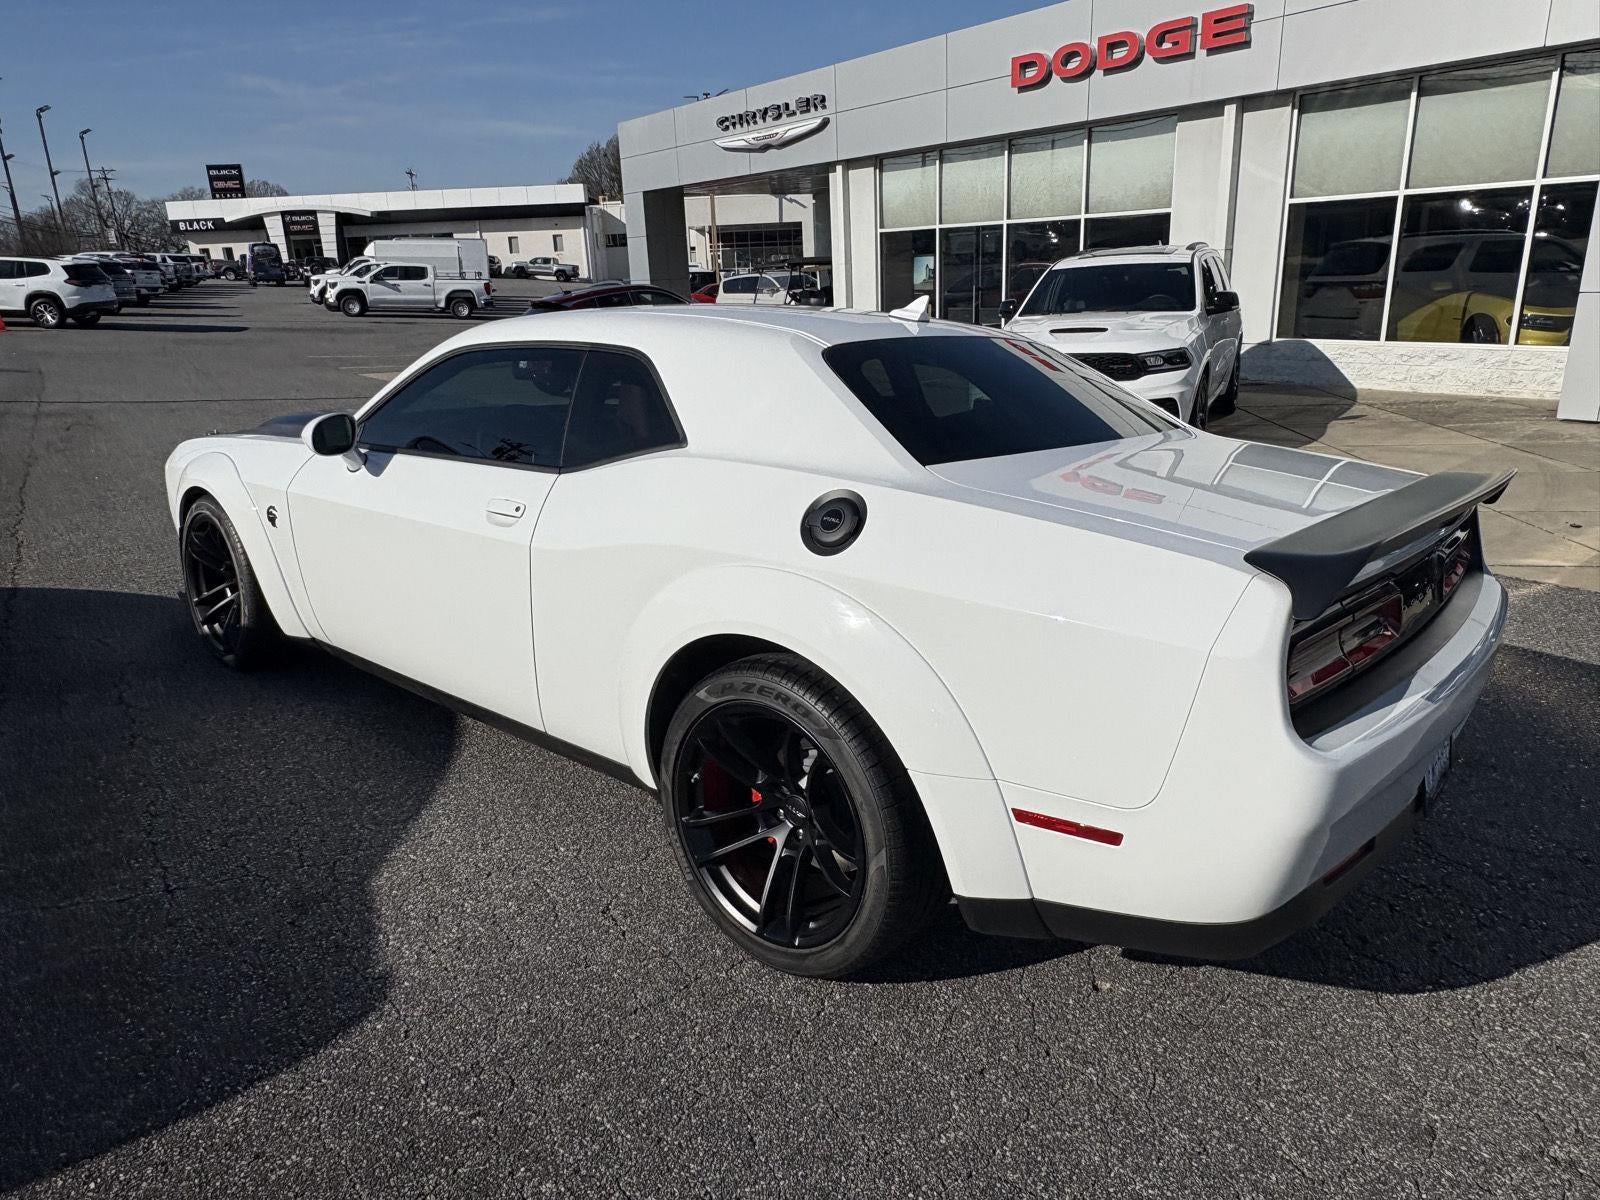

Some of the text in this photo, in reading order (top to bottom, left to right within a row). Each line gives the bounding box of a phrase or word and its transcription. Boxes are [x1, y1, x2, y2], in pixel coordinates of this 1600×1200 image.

[1011, 3, 1254, 92] DODGE
[716, 94, 828, 132] CHRYSLER
[213, 180, 241, 189] GMC
[179, 220, 215, 231] BLACK
[291, 214, 316, 222] BUICK
[739, 681, 813, 719] ZERO
